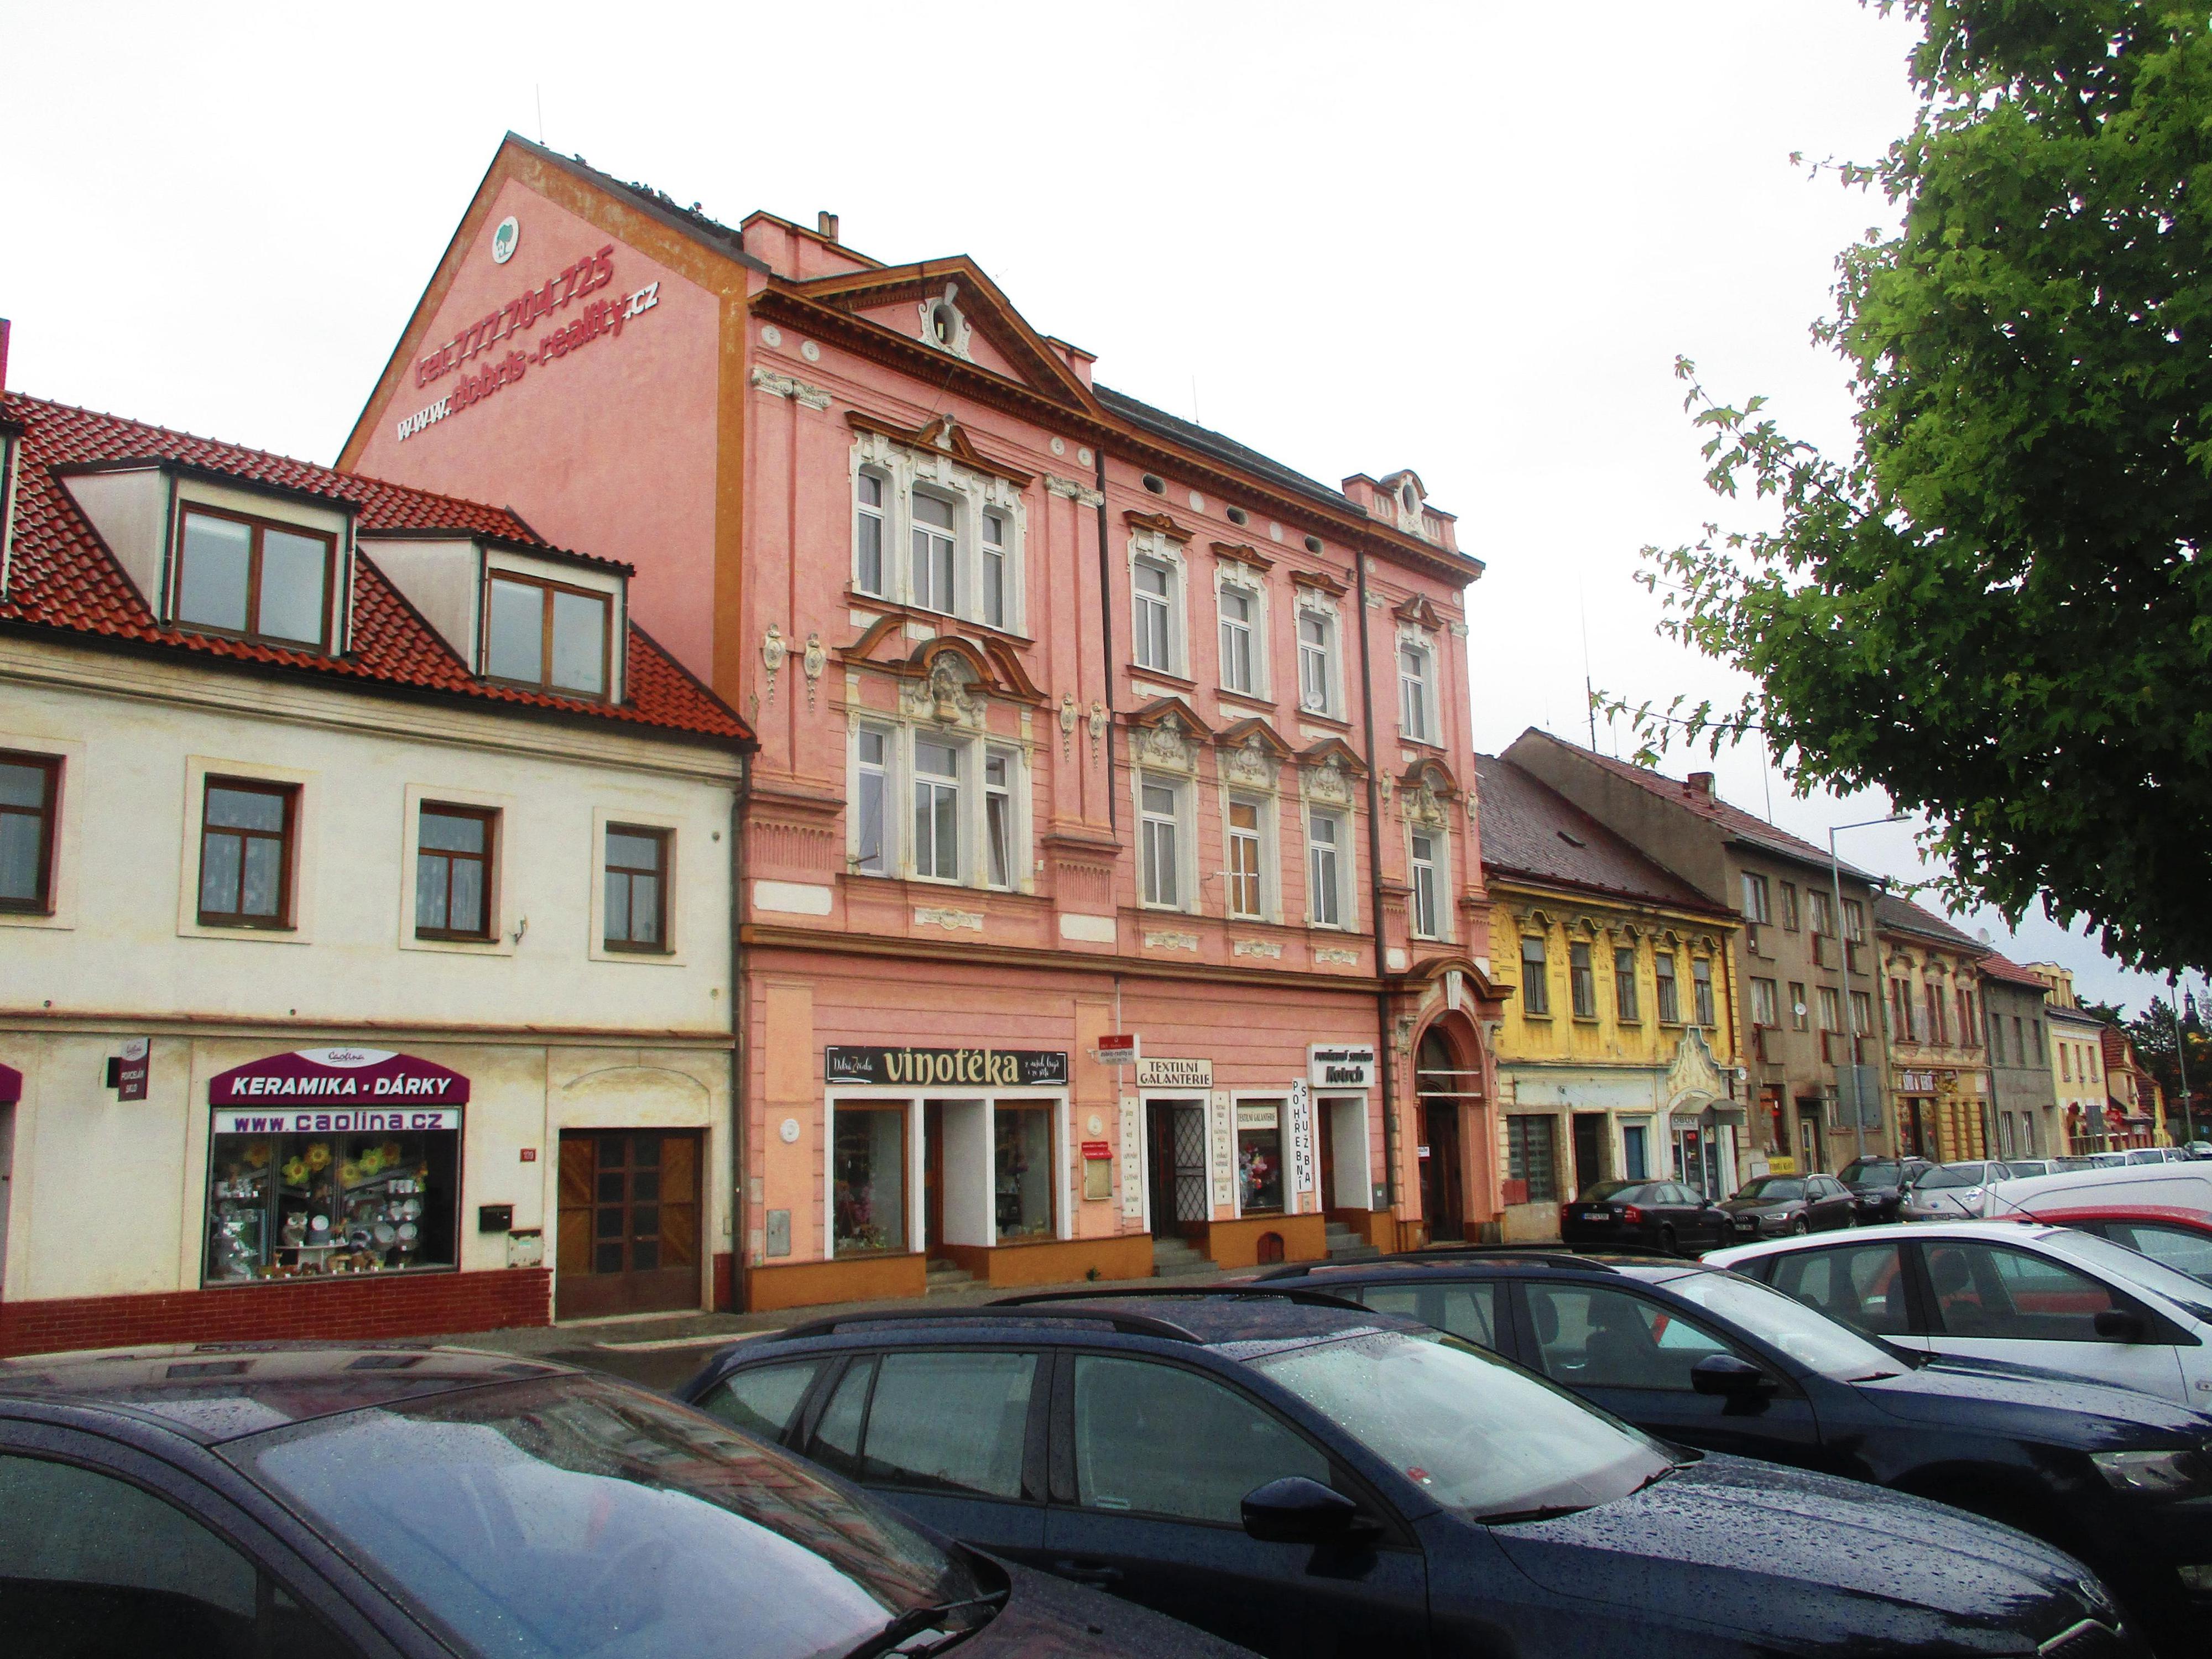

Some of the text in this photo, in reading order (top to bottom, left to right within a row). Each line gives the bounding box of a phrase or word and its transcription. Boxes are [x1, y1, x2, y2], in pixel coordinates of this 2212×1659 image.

[455, 310, 499, 368] 777
[504, 279, 554, 340] 704
[559, 243, 614, 309] 725
[398, 281, 659, 442] www.dobris-reality.cz
[328, 1051, 364, 1062] Caolina
[883, 1046, 1020, 1087] vinotéka
[1149, 1060, 1198, 1073] TEXTILNÍ
[231, 1073, 452, 1095] KERAMIKA DÁRKY
[1140, 1073, 1210, 1085] GALANTERIE
[1293, 1081, 1303, 1190] POHŘEBNÍ
[1301, 1086, 1311, 1183] SLUŽBA
